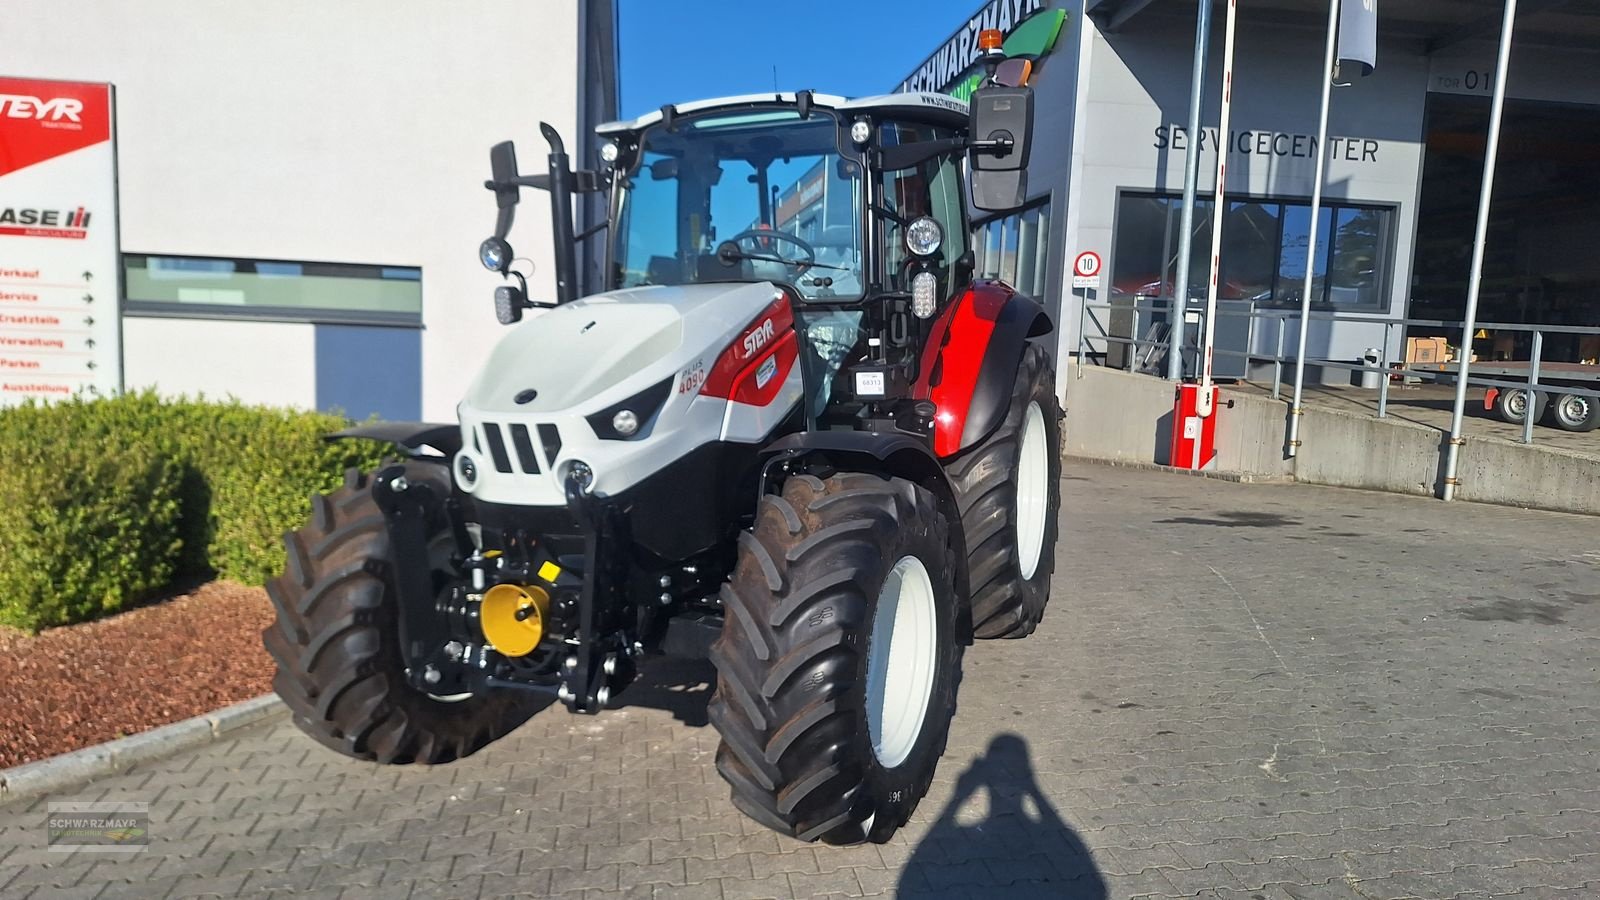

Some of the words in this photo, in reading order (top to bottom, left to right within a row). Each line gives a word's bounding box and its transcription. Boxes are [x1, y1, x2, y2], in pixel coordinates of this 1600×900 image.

[911, 0, 1040, 93] SCHWARZMAY
[1438, 77, 1460, 88] TOR
[1464, 70, 1490, 91] 01
[1083, 258, 1093, 271] 10
[0, 337, 64, 348] Verwaltung
[742, 318, 775, 359] STEYR
[0, 359, 40, 369] Parken
[3, 383, 70, 394] Ausstellung
[679, 369, 704, 394] 4090
